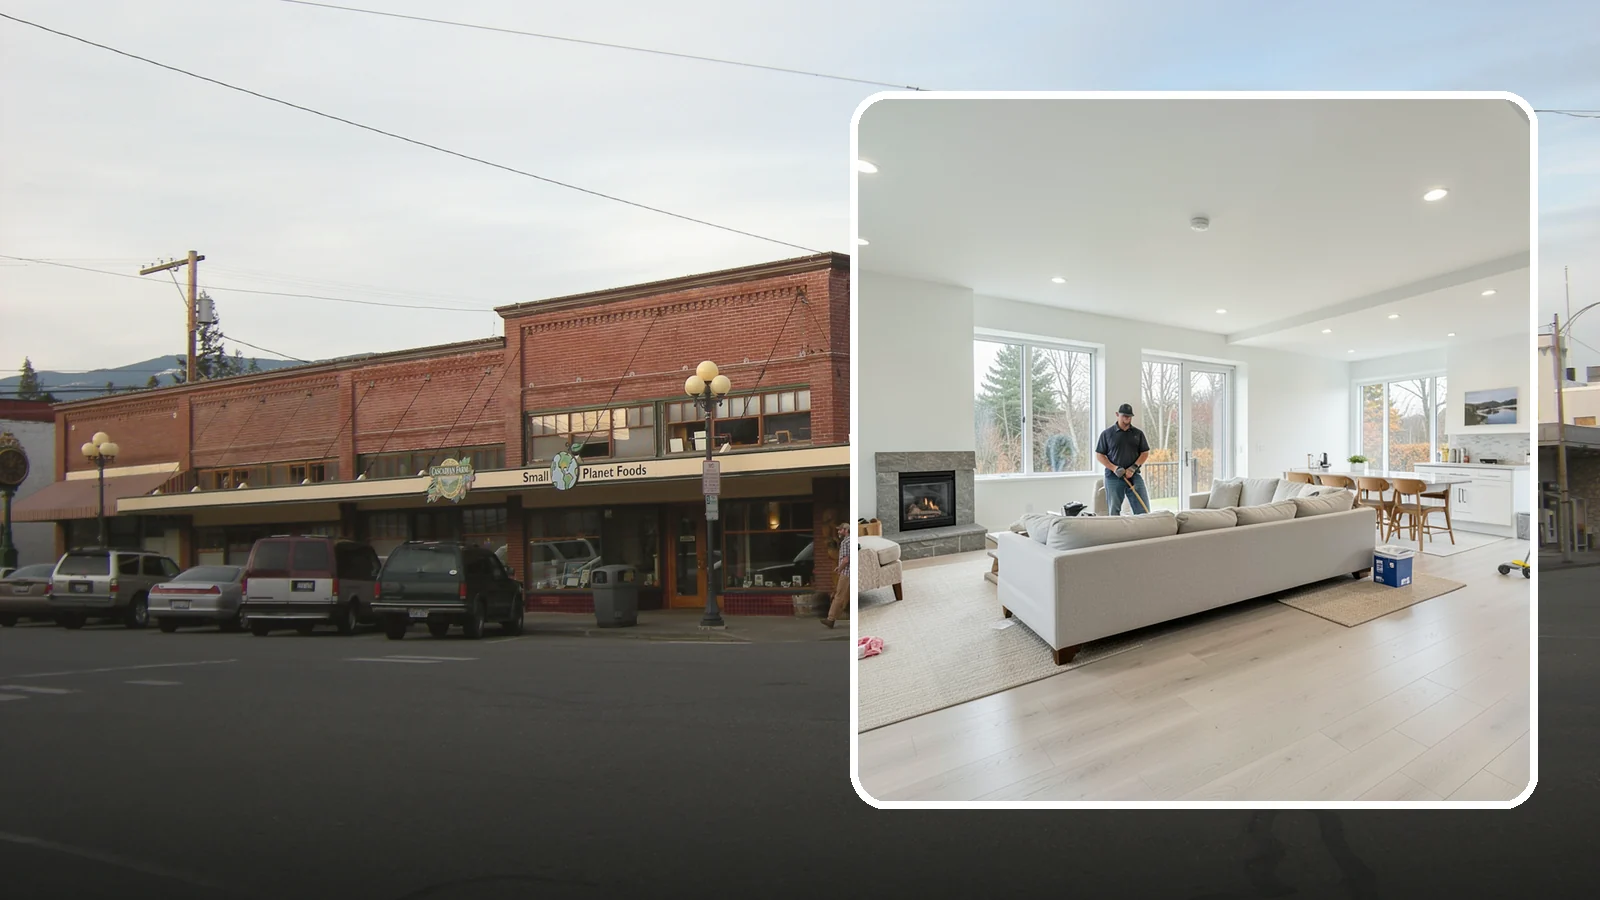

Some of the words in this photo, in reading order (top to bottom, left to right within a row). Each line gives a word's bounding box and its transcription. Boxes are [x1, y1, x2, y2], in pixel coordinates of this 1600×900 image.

[523, 471, 549, 483] Small
[583, 467, 614, 480] Planet
[617, 464, 647, 477] Foods
